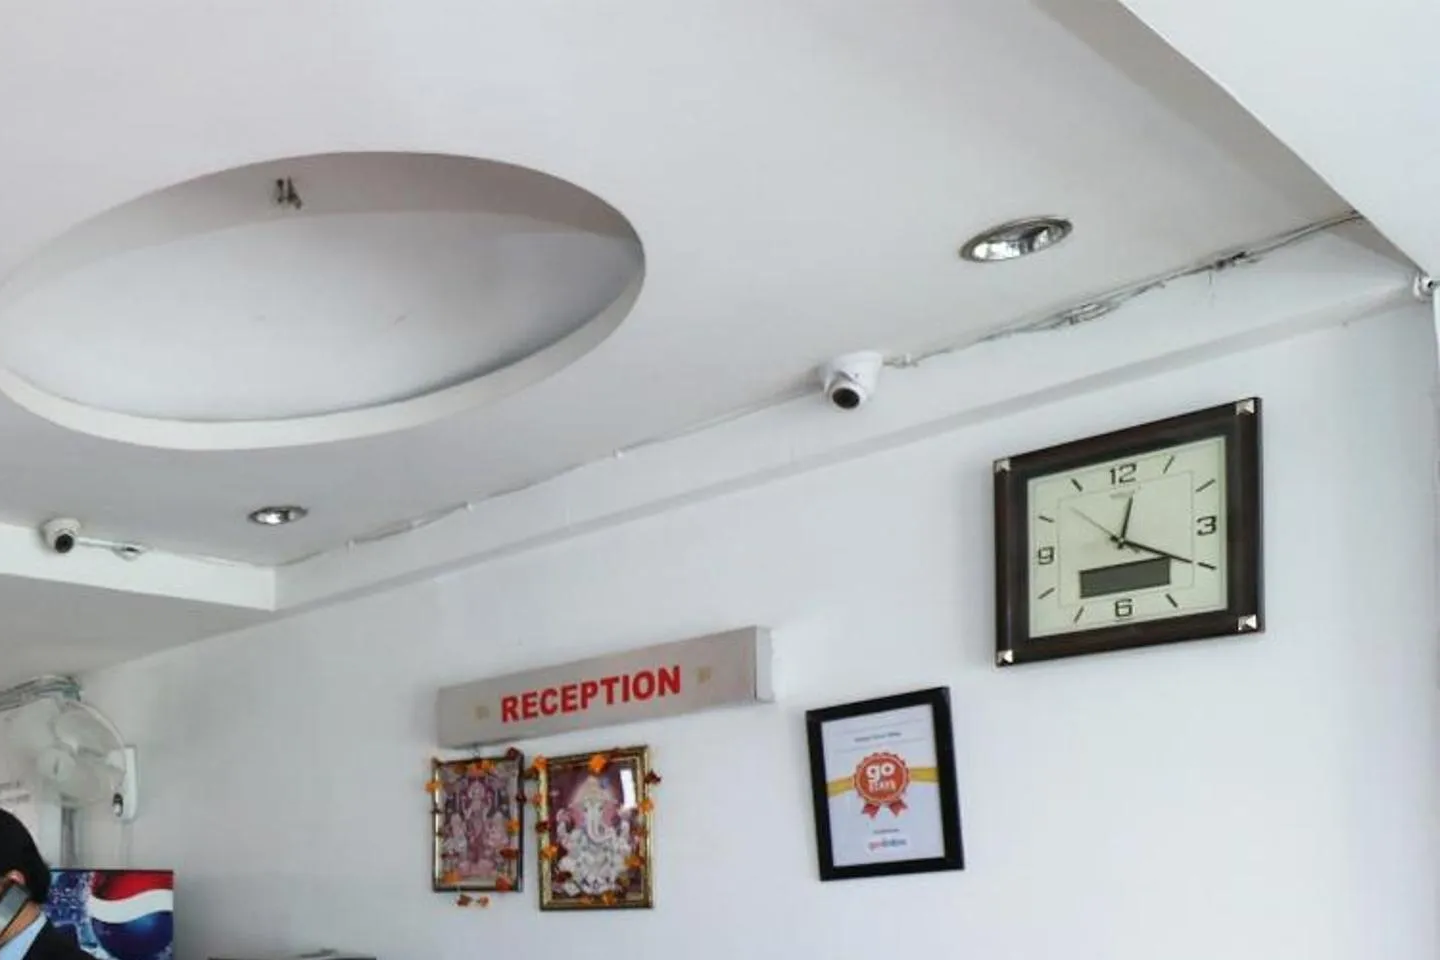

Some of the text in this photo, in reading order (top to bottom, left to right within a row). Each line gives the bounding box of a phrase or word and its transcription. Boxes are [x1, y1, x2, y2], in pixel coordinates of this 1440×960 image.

[1109, 463, 1138, 486] 12
[1196, 515, 1217, 536] 3
[1037, 546, 1055, 565] 9
[1114, 599, 1133, 617] 6
[501, 666, 681, 723] RECEPTION
